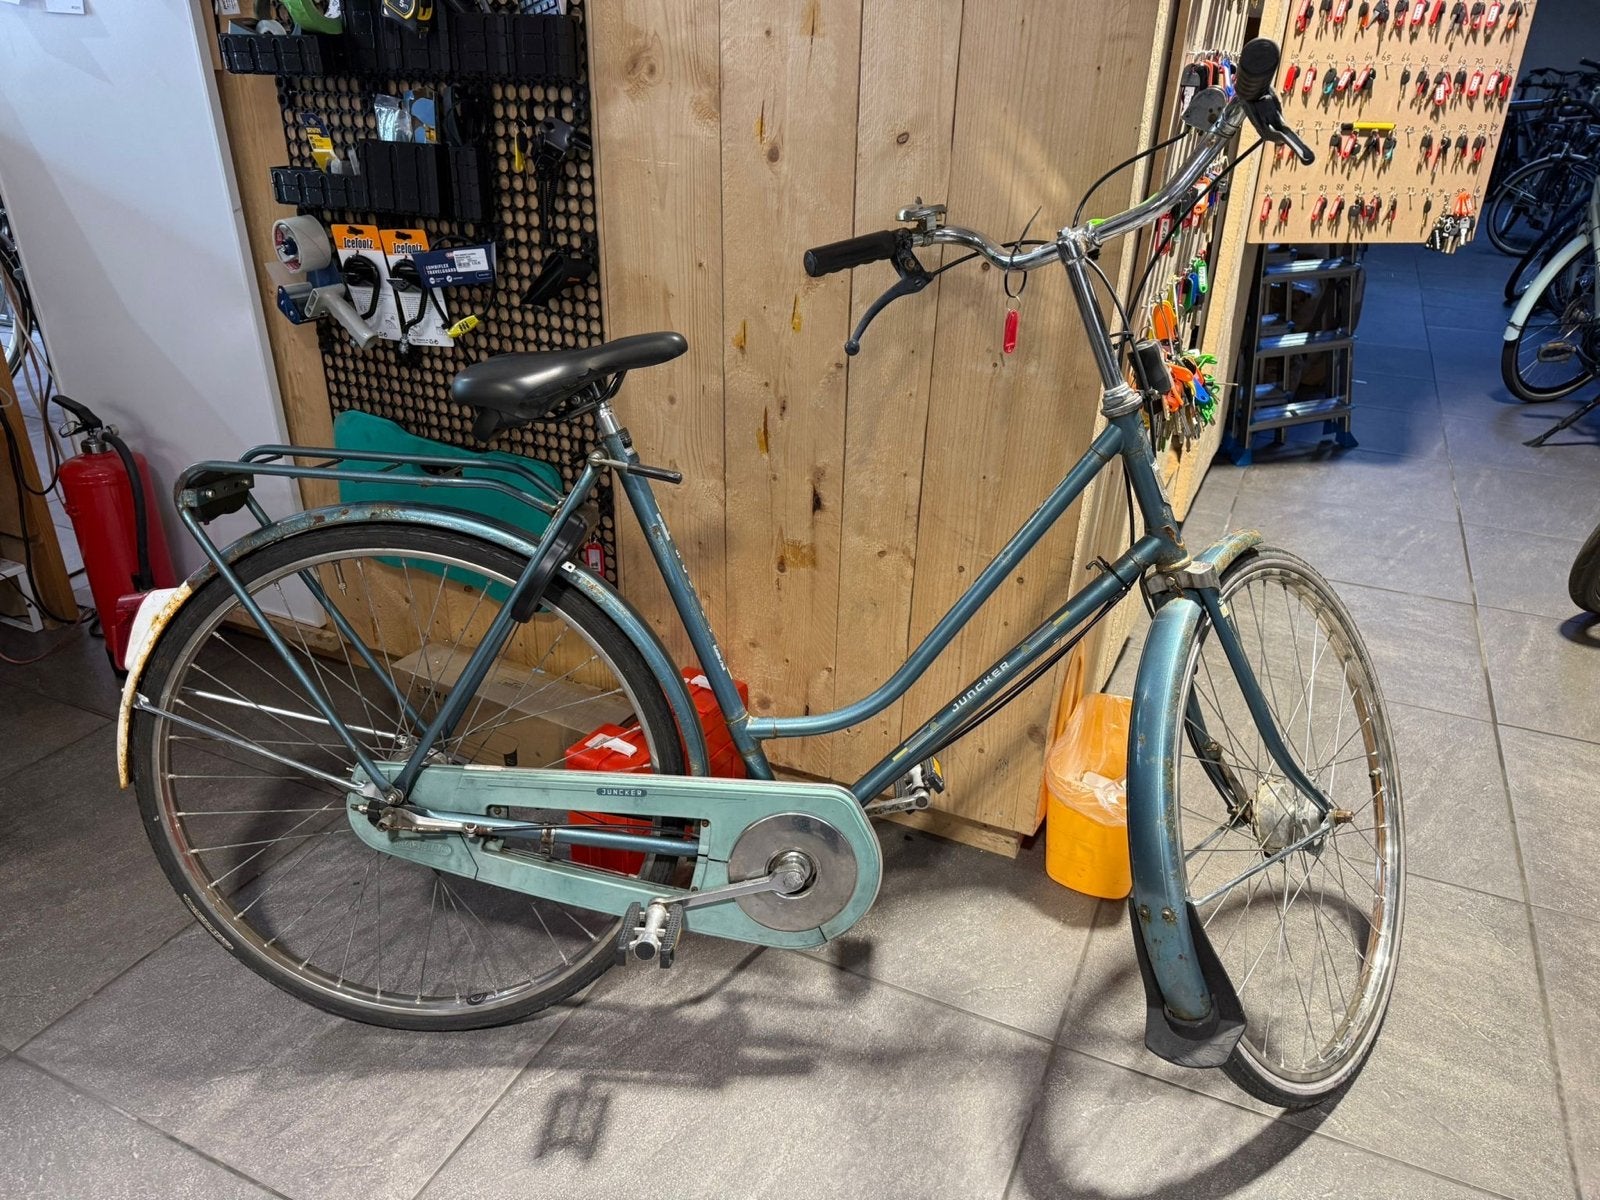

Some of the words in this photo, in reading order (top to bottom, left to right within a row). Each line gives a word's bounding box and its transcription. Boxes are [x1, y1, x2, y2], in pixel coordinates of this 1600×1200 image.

[1381, 51, 1392, 61] 65
[1401, 52, 1412, 62] 66
[343, 237, 374, 249] IceToolz
[952, 661, 1009, 712] JUNCKER
[601, 788, 642, 796] JUNCKER
